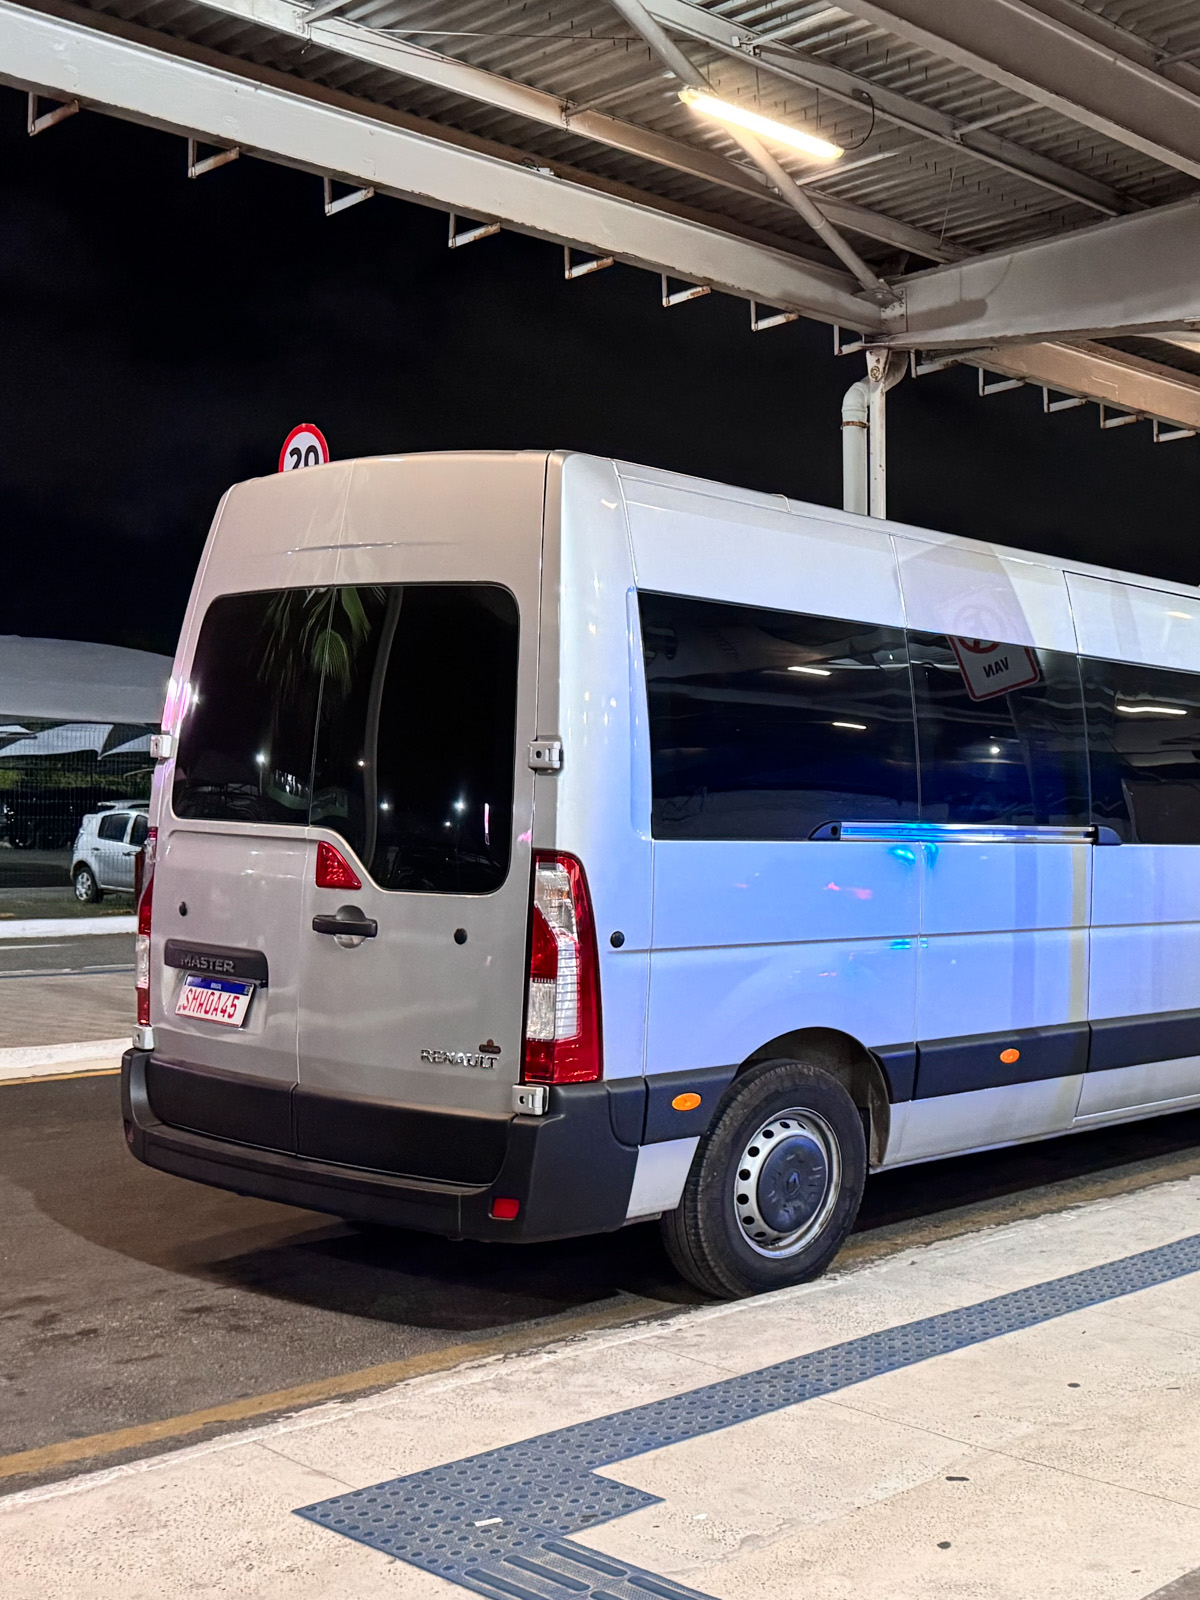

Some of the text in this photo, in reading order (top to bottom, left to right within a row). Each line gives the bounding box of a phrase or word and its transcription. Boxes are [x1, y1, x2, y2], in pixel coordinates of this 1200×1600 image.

[289, 445, 319, 470] 20
[180, 953, 235, 973] MASTER
[420, 1048, 500, 1069] RENAULT
